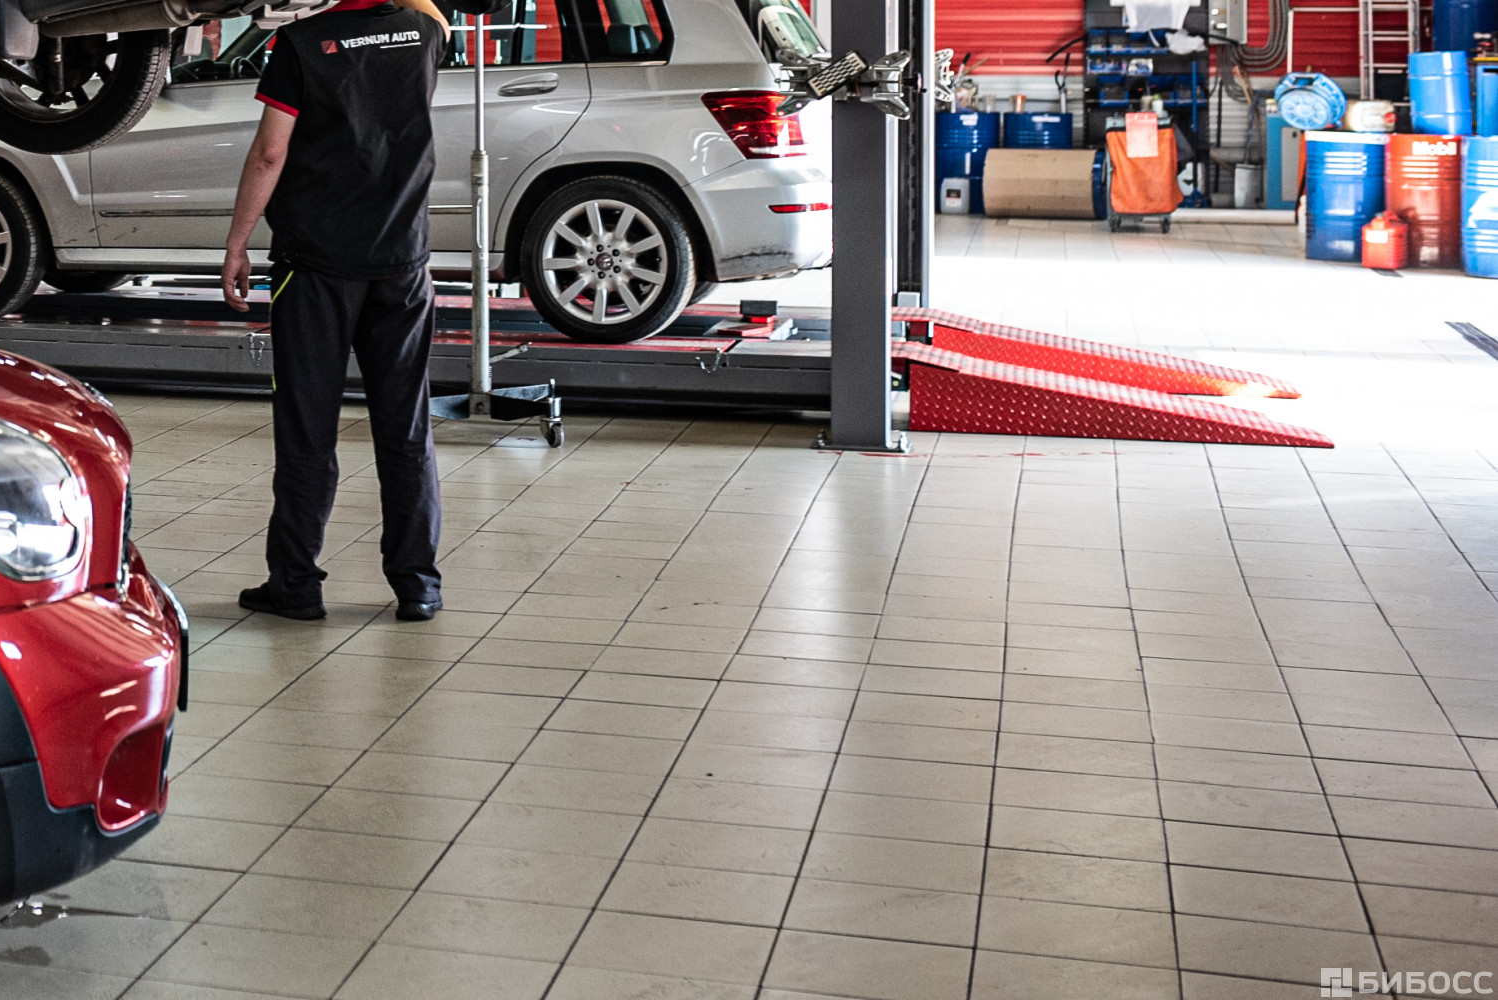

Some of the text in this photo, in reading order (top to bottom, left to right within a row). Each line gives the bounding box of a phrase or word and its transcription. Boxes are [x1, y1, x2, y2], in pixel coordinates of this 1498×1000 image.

[340, 30, 421, 49] VERNUM AUTO
[1412, 141, 1457, 156] Mobil
